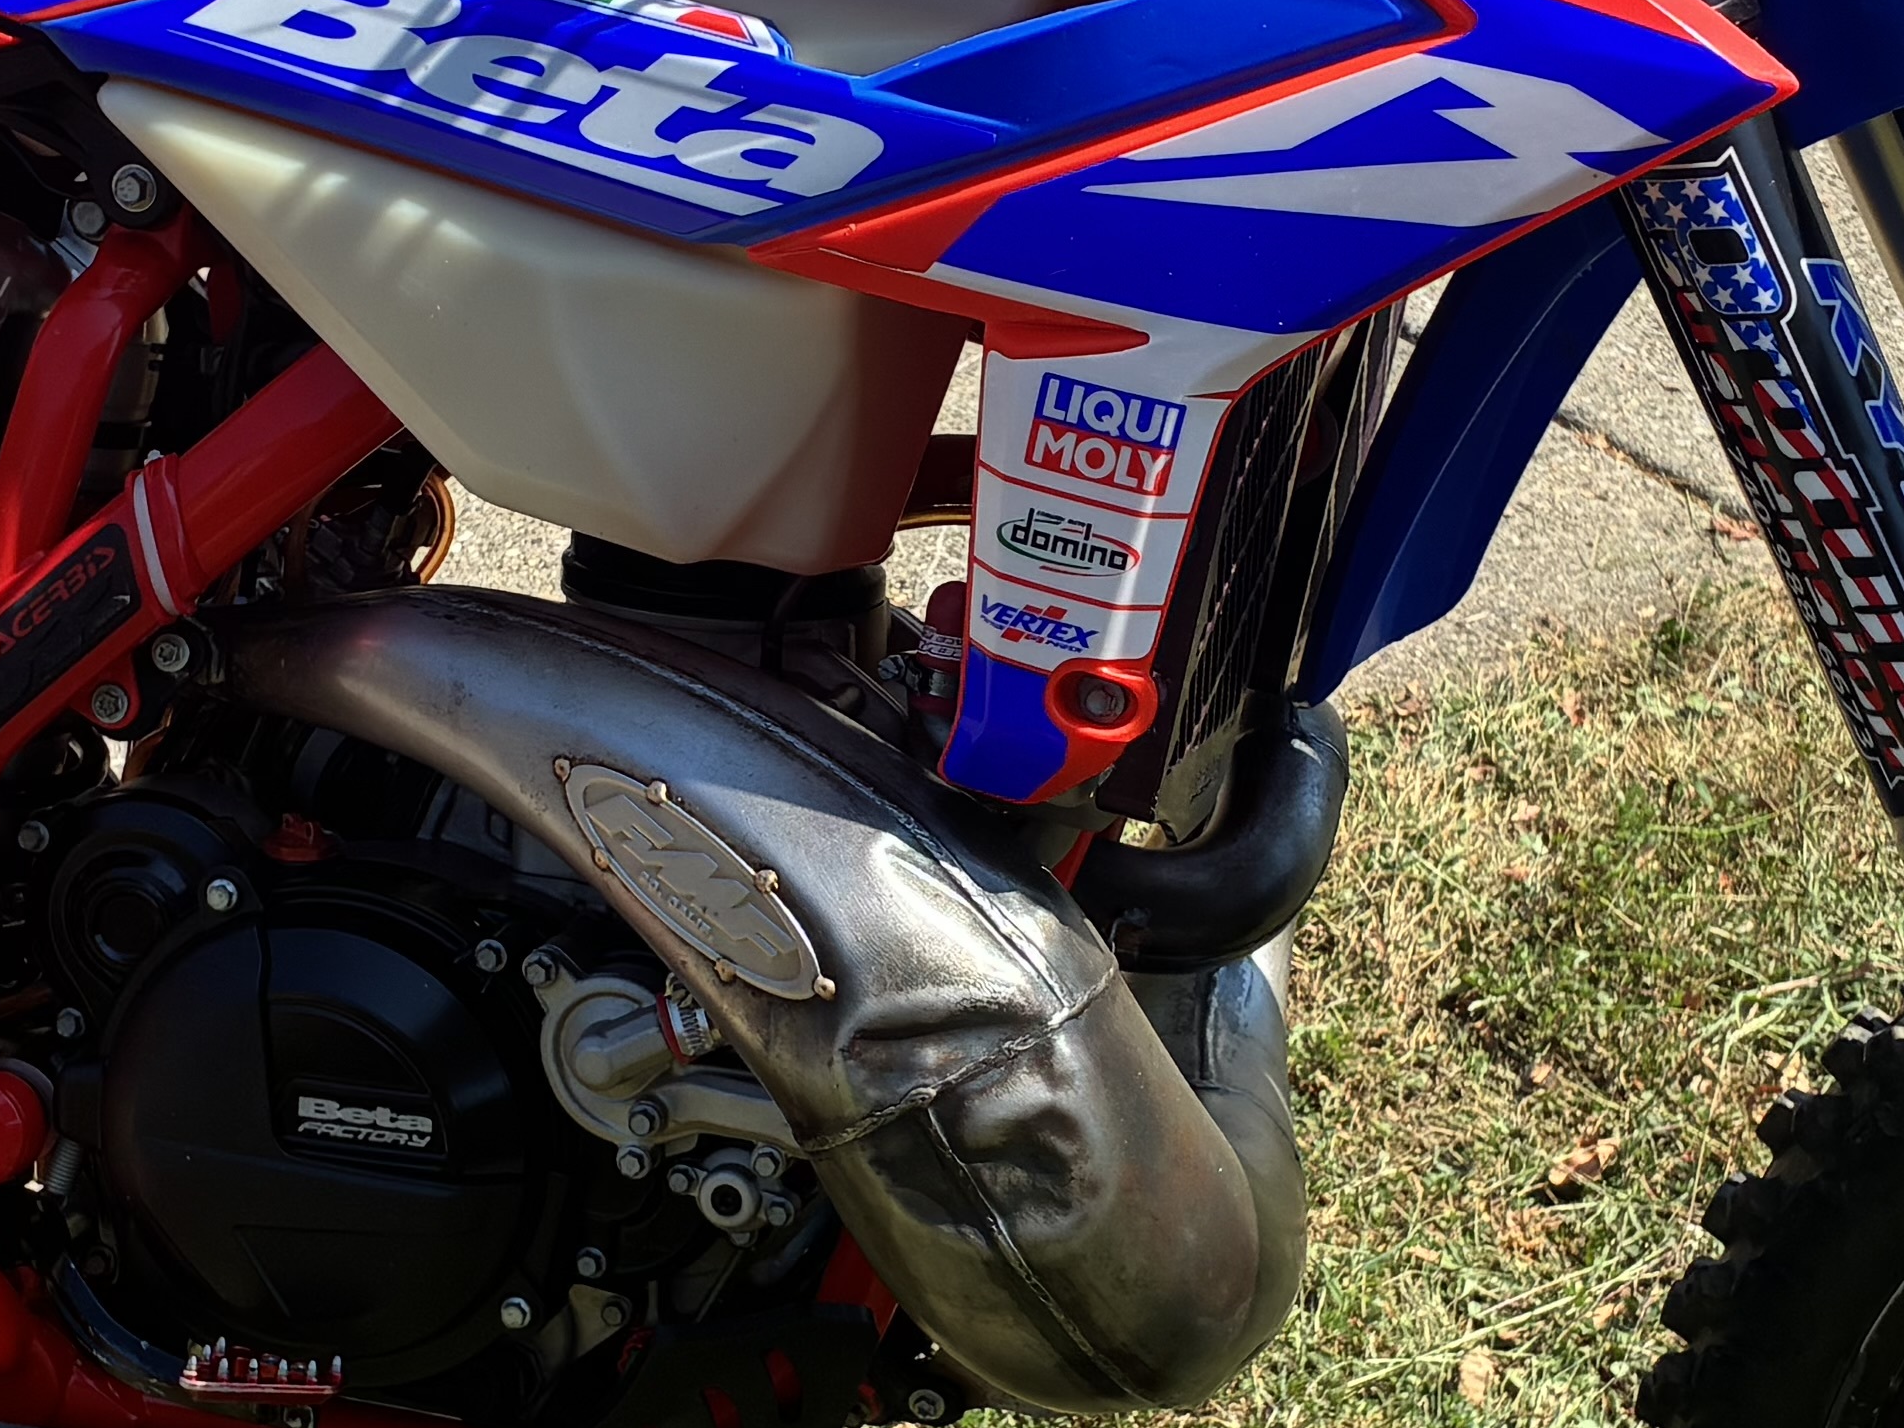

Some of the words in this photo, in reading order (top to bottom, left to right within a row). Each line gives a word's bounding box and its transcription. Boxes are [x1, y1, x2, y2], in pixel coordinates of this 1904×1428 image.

[1040, 375, 1182, 448] LIQUI
[1030, 422, 1172, 493] MOLY
[1010, 507, 1131, 572] domino
[979, 593, 1100, 650] VERTEX
[584, 793, 800, 958] FMF
[297, 1121, 432, 1148] FACTORY
[298, 1096, 433, 1135] Beta
